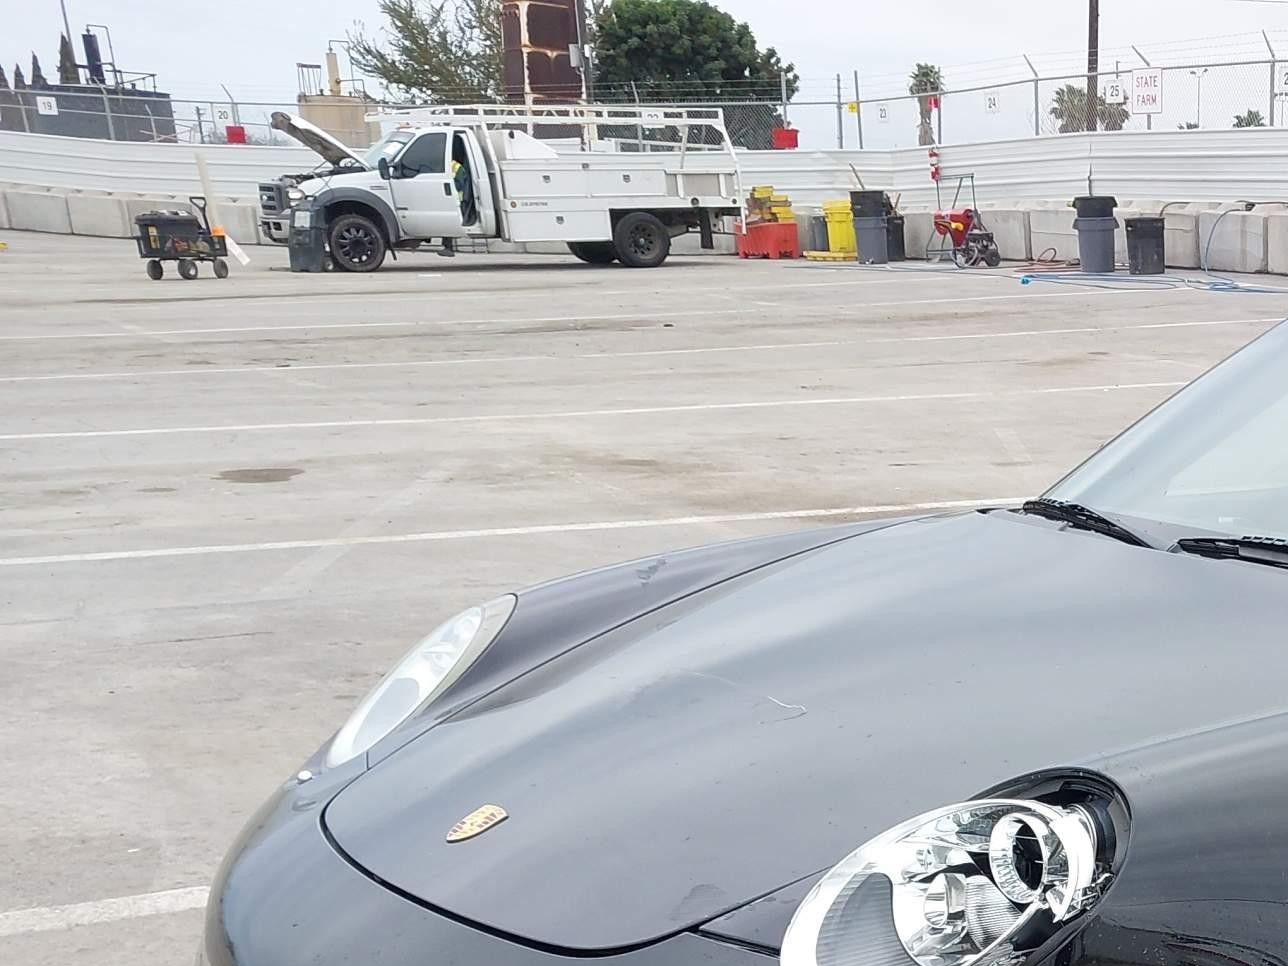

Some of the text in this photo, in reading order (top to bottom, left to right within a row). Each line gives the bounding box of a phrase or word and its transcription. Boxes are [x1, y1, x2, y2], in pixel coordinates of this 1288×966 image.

[1135, 75, 1158, 88] STATE
[1109, 84, 1120, 97] 25
[42, 101, 52, 111] 19
[987, 97, 997, 109] 24
[1136, 94, 1157, 106] FARM
[218, 110, 229, 120] 20
